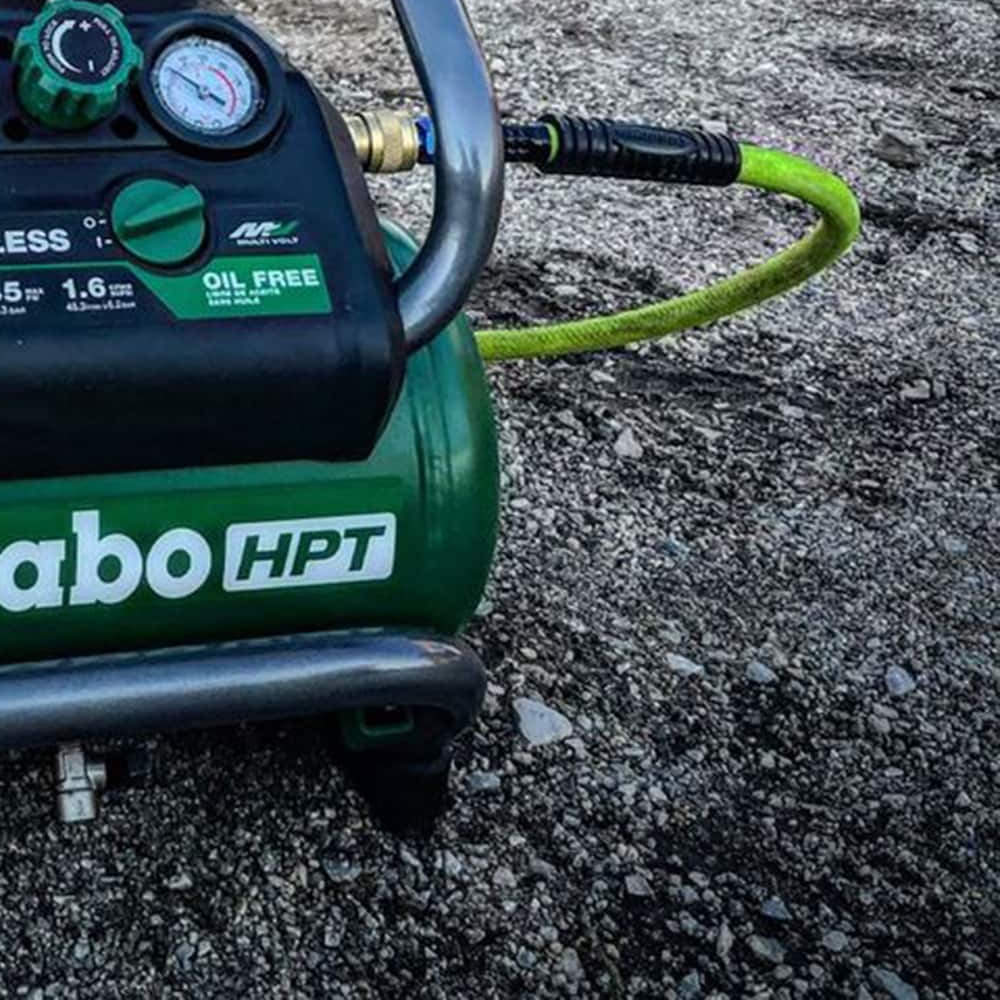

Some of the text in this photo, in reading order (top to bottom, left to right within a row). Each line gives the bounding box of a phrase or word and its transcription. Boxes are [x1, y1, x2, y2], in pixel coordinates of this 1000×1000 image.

[61, 276, 107, 299] 1.6
[202, 268, 320, 290] OIL FREE
[234, 523, 386, 584] HPT
